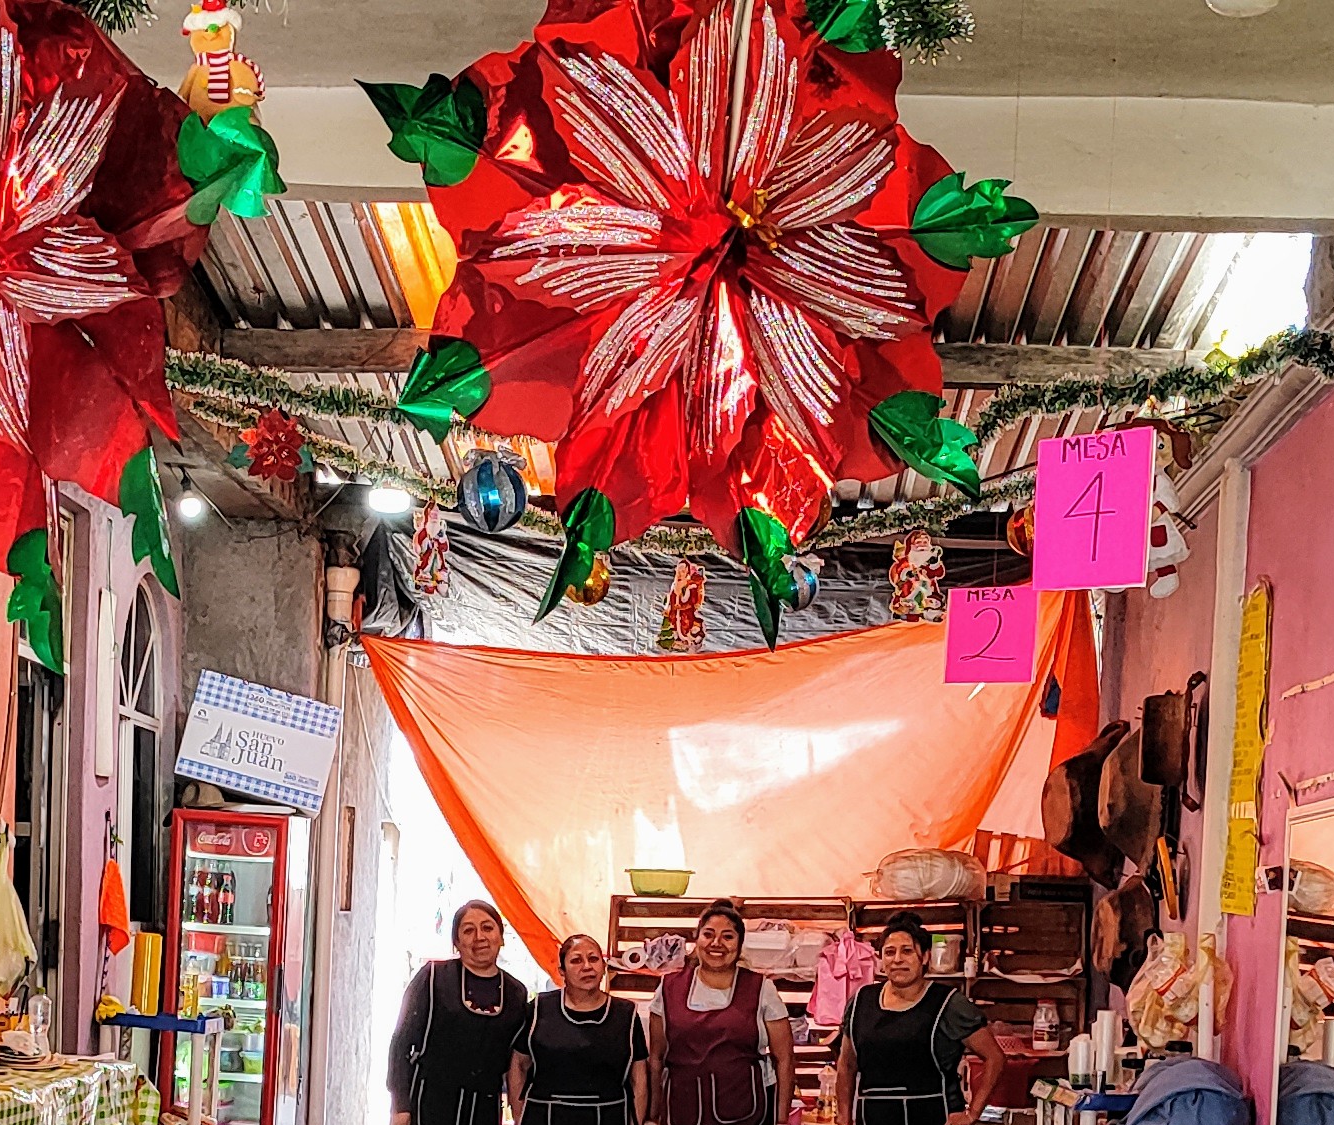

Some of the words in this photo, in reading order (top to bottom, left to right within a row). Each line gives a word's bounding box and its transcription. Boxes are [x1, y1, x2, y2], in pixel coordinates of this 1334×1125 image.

[1062, 432, 1127, 464] MESA
[1063, 471, 1116, 562] 4
[966, 588, 1015, 602] MESA
[959, 607, 1016, 661] 2
[235, 730, 273, 756] San
[231, 748, 283, 773] Juan
